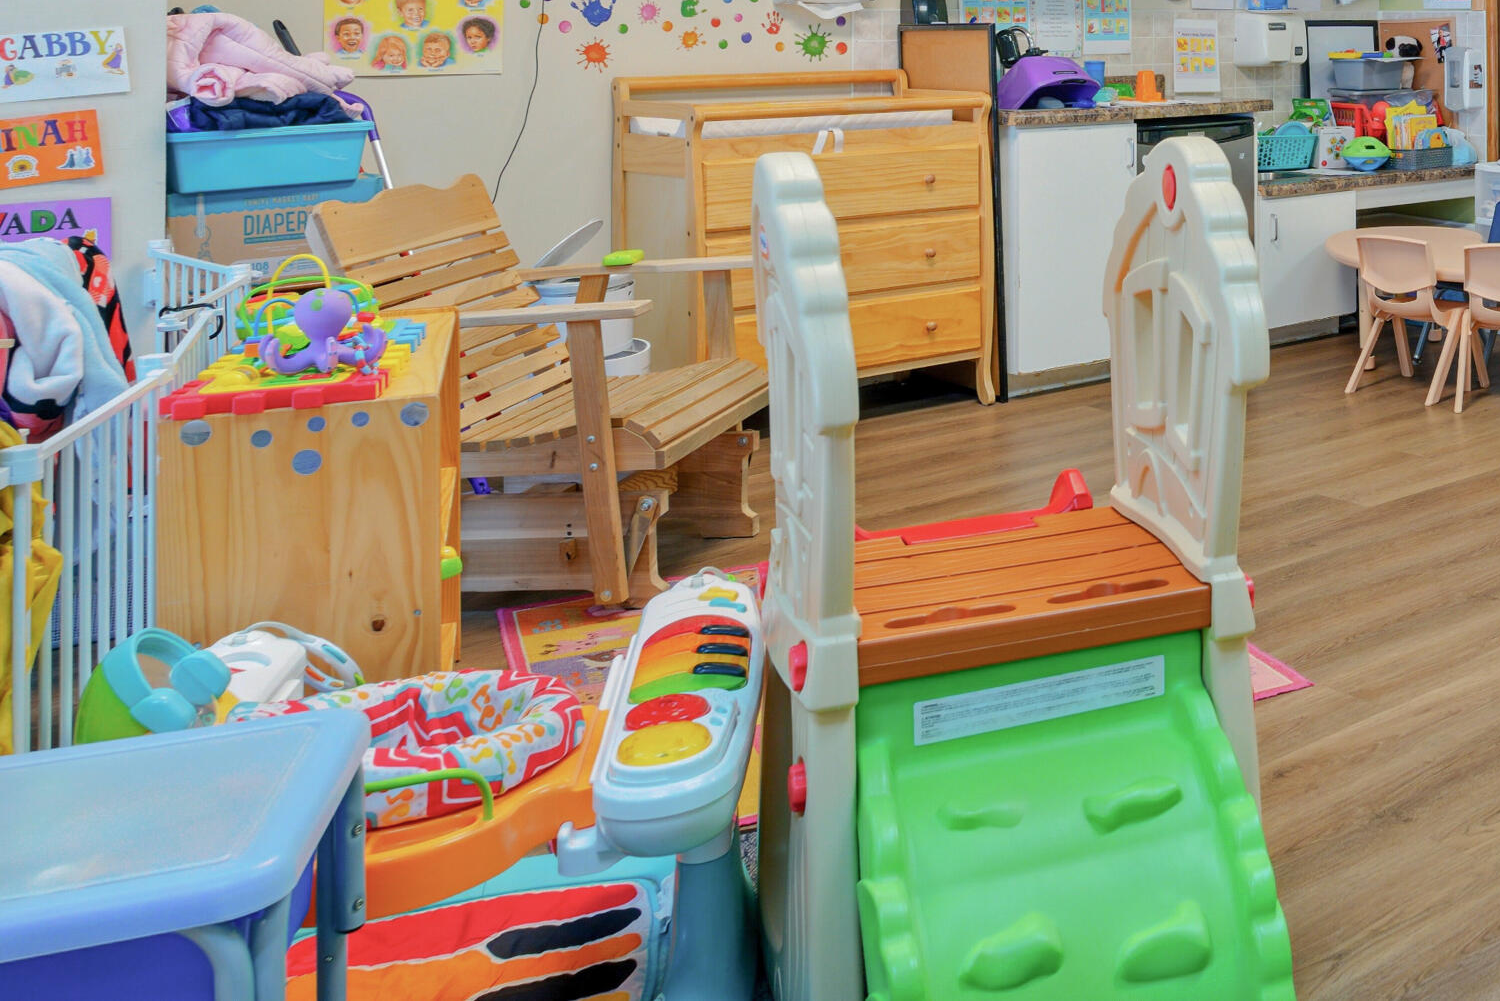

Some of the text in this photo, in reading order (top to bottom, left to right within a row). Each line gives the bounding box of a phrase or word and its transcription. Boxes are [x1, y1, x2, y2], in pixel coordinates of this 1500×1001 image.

[0, 30, 115, 62] GABBY
[0, 119, 88, 152] INAH
[243, 210, 312, 237] DIAPER
